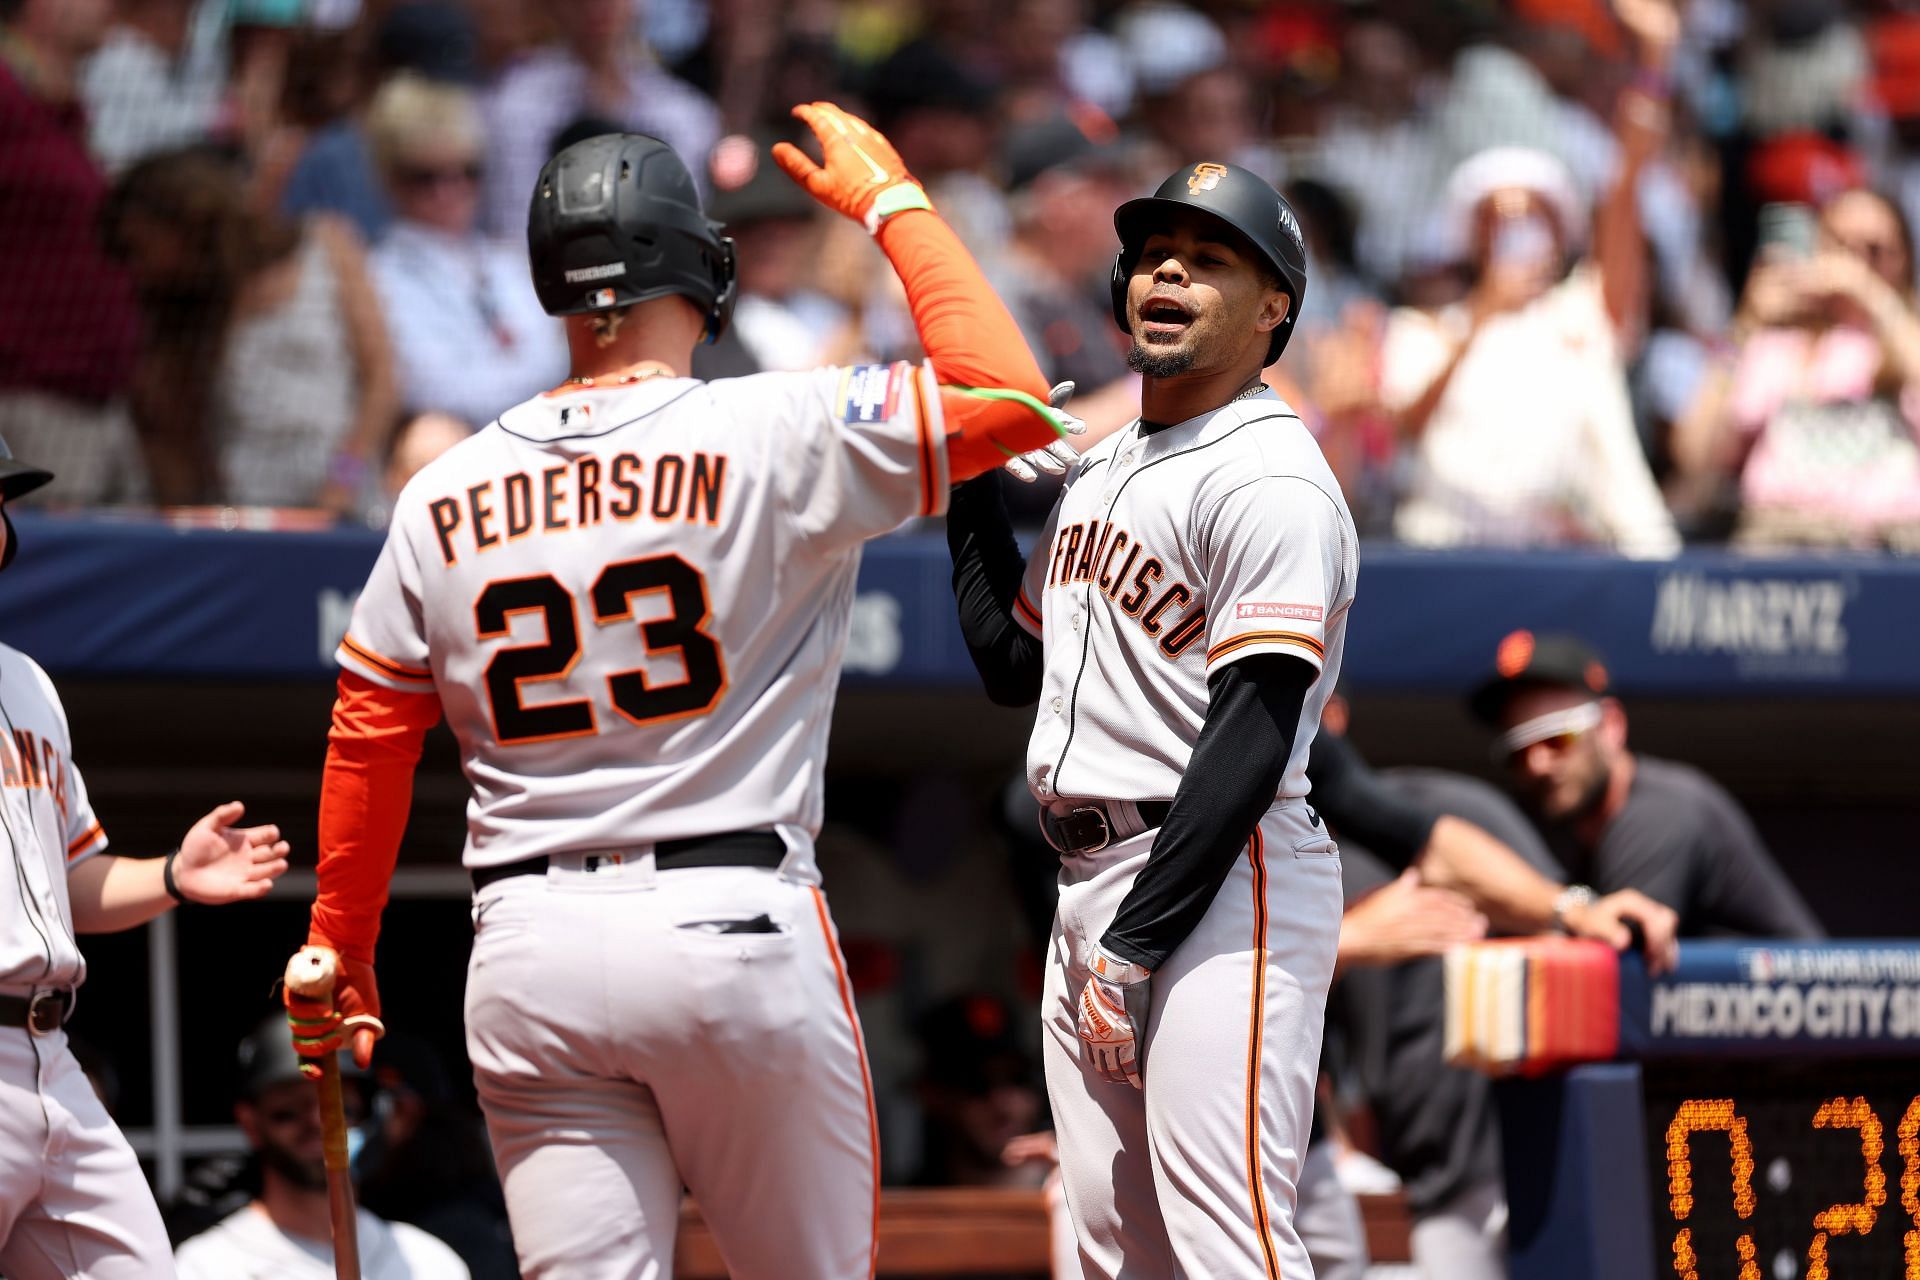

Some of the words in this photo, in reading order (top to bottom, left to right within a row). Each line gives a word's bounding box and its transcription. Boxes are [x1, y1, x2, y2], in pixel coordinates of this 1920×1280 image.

[428, 452, 727, 568] PEDERSON
[473, 551, 728, 746] 23
[1257, 605, 1320, 618] BANORTE
[1651, 982, 1802, 1039] MEXICO
[1805, 984, 1888, 1039] CITY
